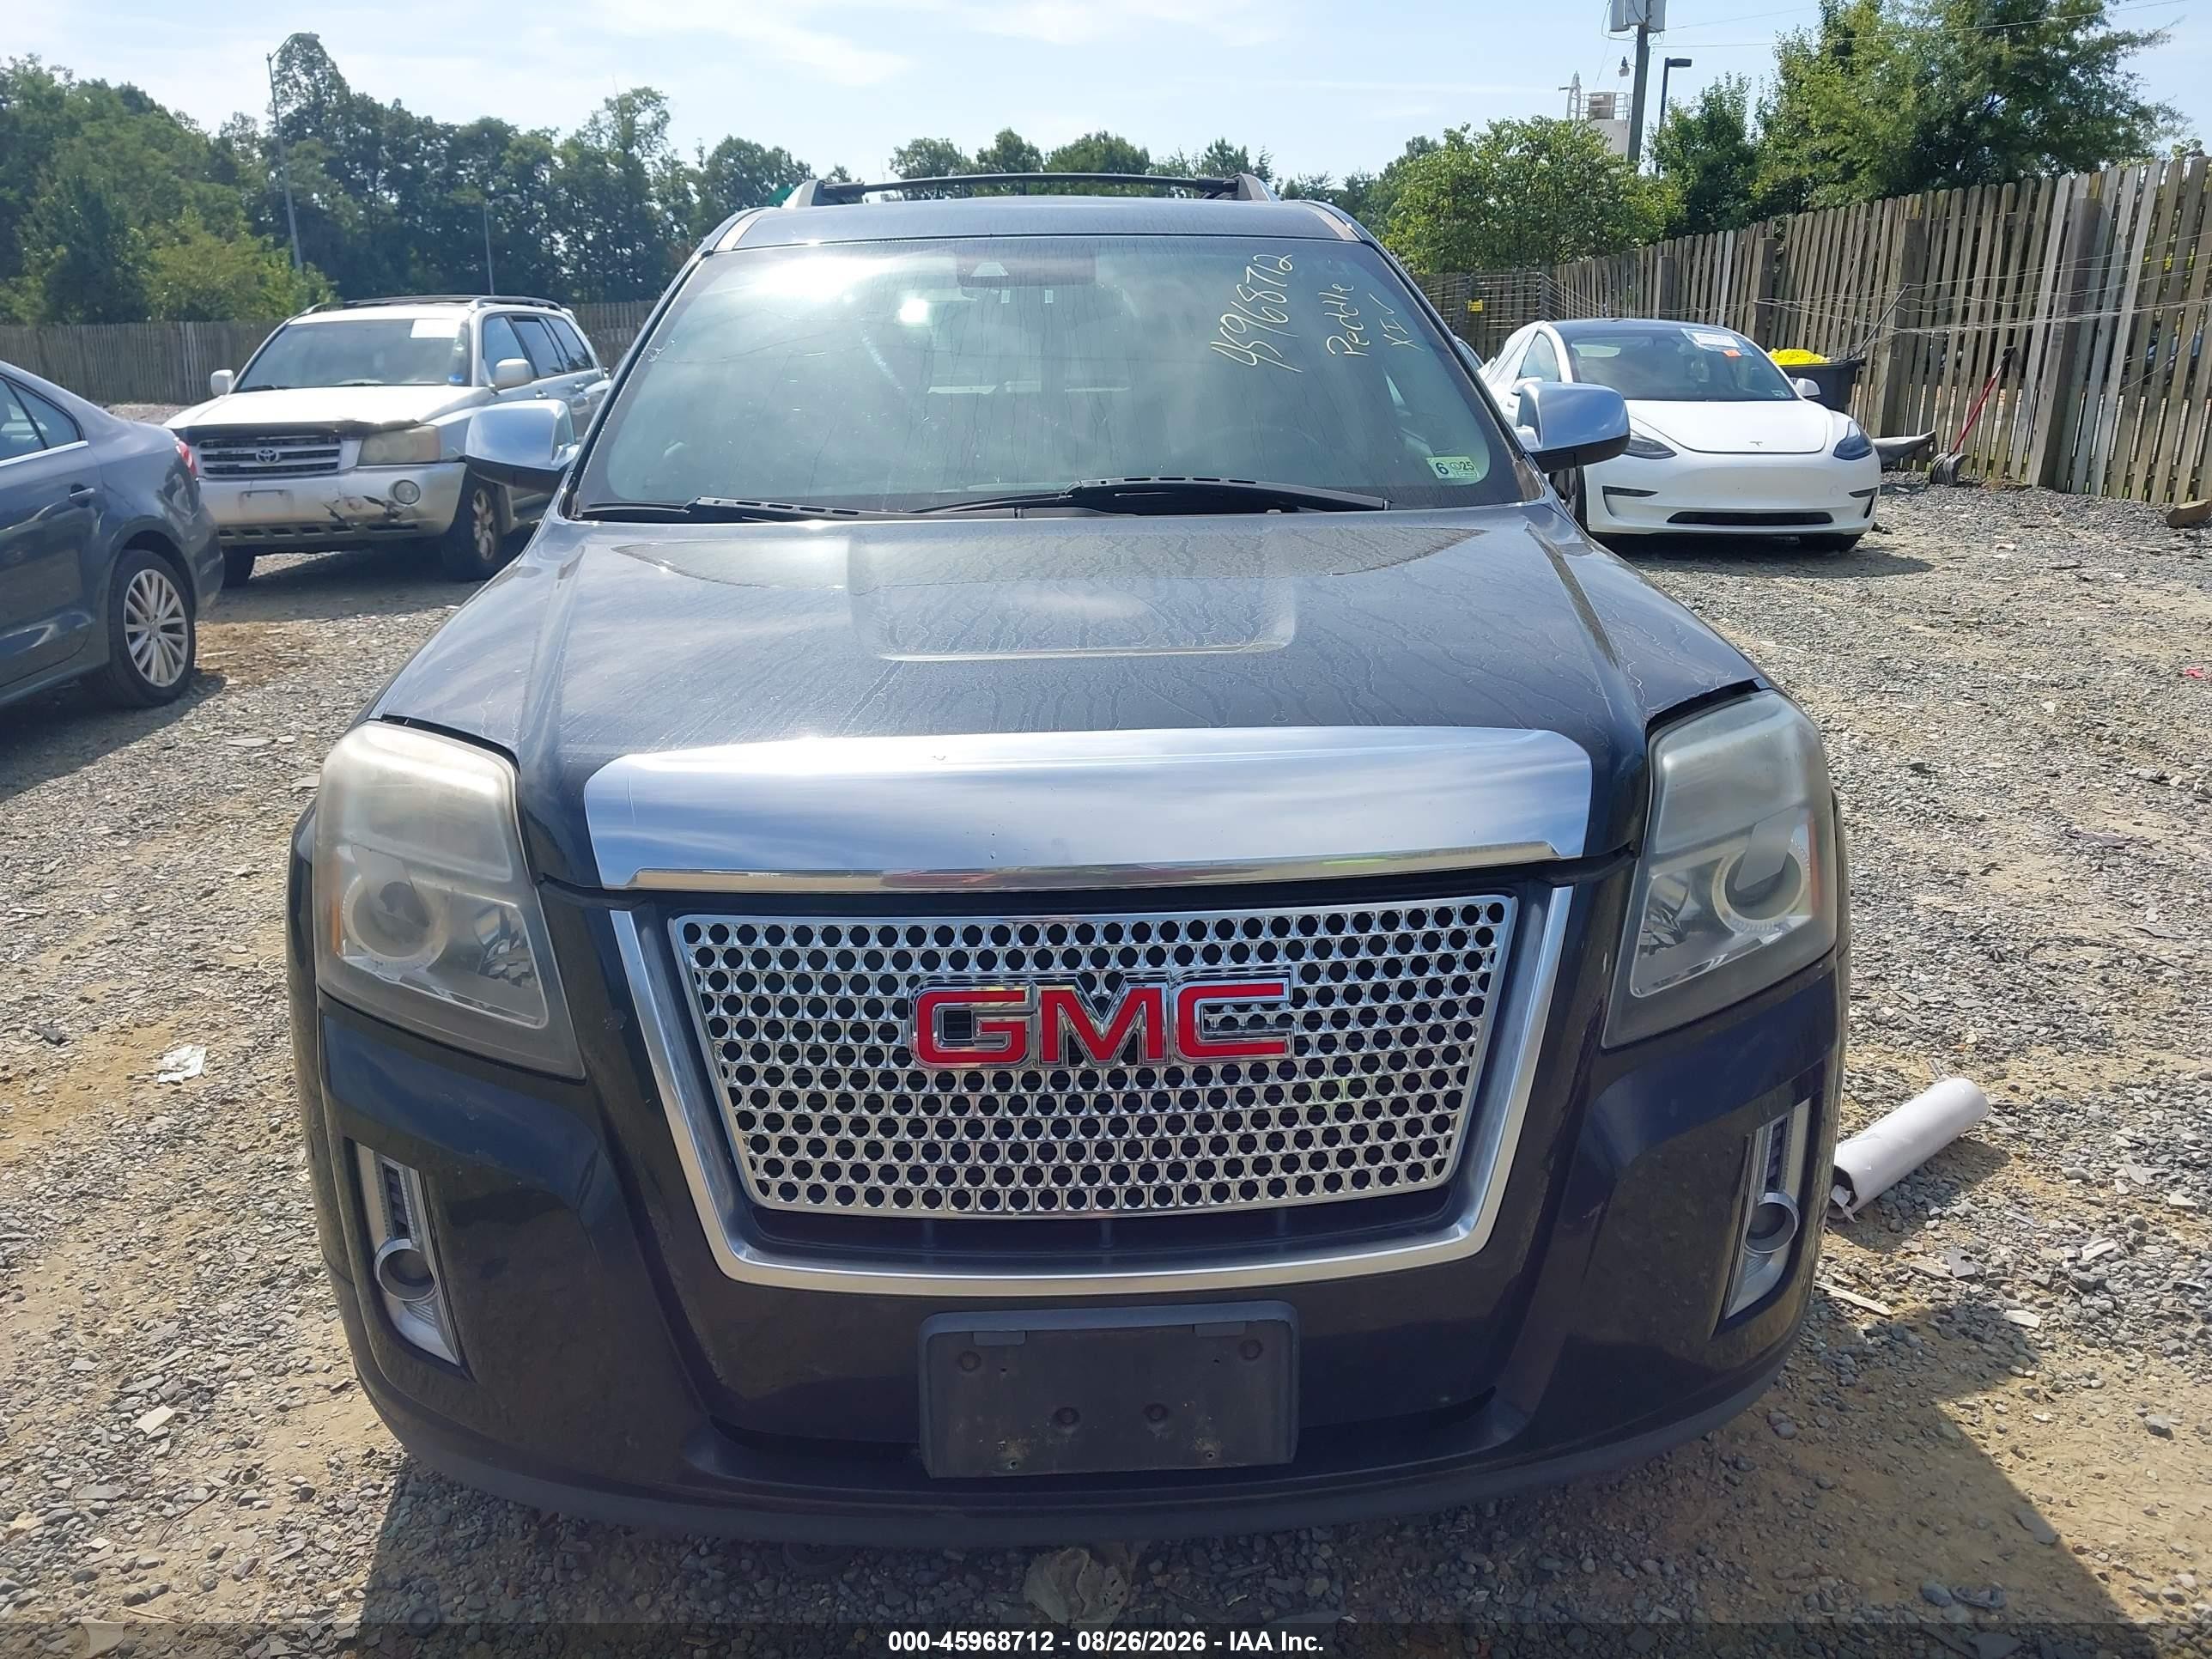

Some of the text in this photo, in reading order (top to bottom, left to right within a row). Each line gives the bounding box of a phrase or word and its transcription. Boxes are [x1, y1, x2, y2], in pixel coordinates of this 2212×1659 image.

[1209, 253, 1304, 373] 45968712
[1435, 461, 1474, 475] 6 25
[910, 975, 1292, 1067] GMC
